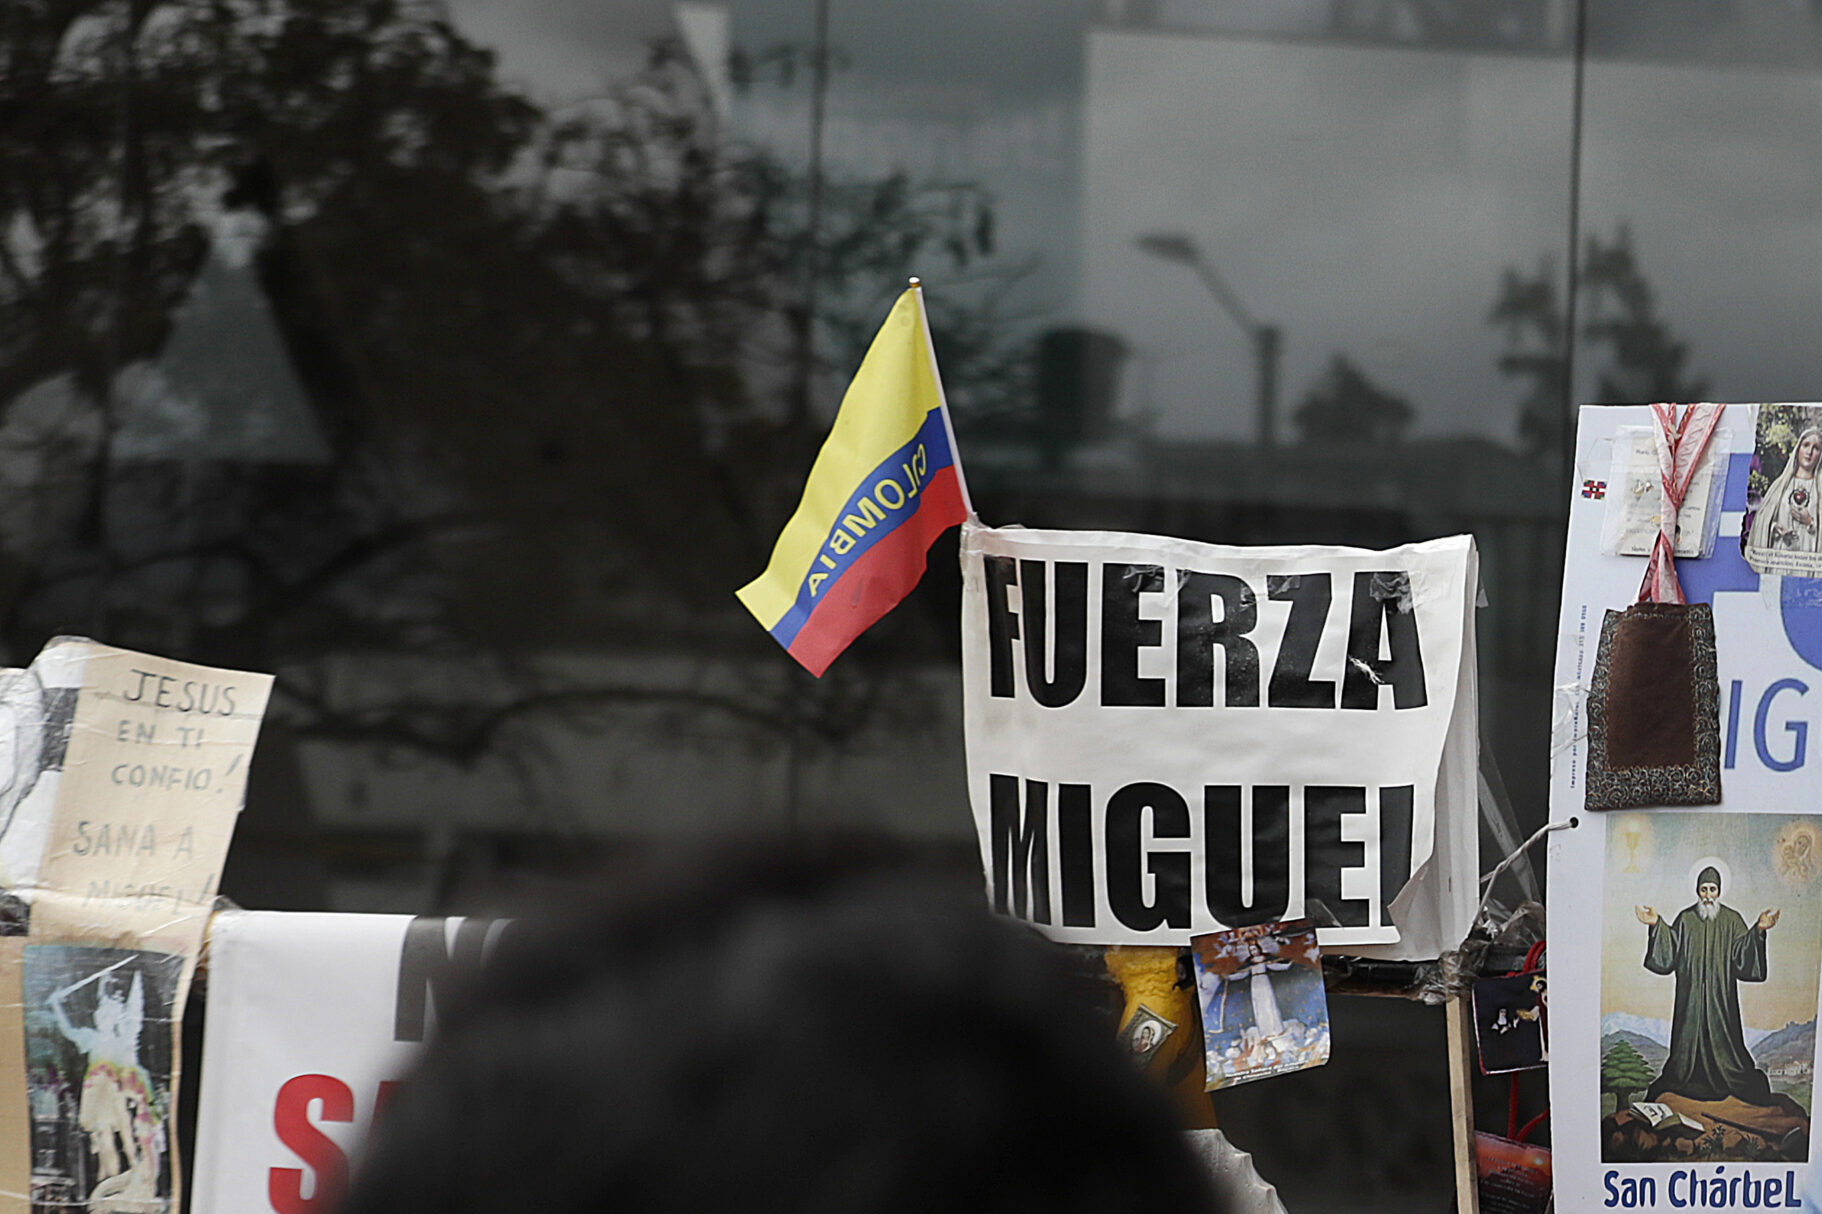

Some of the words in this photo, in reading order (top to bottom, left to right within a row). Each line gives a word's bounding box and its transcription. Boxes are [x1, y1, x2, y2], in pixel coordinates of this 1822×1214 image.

[984, 555, 1429, 711] FUERZA
[123, 668, 238, 718] JESUS
[117, 720, 156, 744] EN
[178, 729, 203, 750] TI
[72, 820, 155, 858] SANA
[171, 826, 194, 861] A
[1604, 1169, 1656, 1208] San
